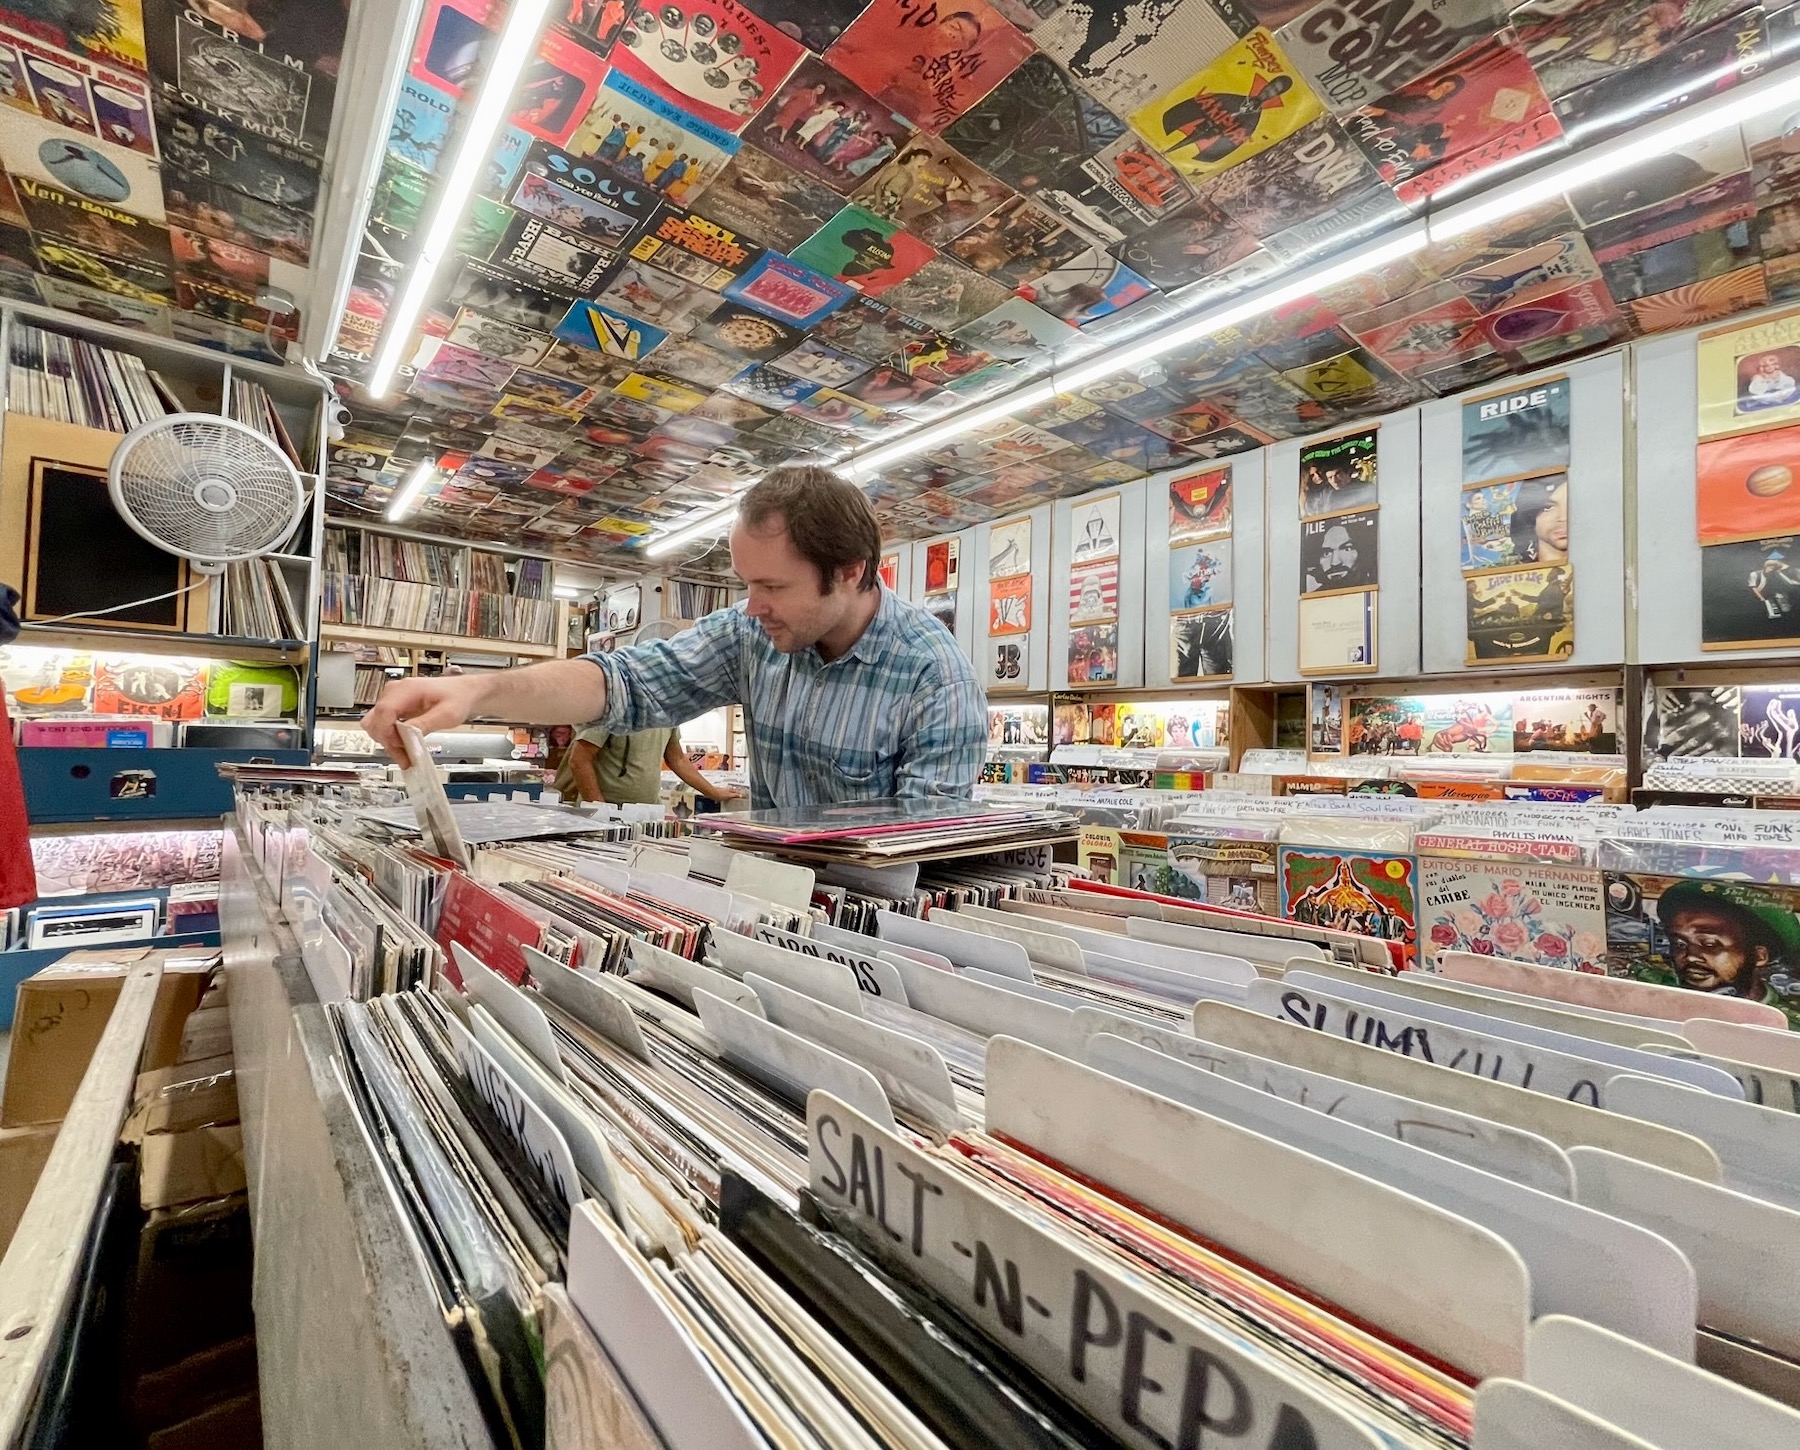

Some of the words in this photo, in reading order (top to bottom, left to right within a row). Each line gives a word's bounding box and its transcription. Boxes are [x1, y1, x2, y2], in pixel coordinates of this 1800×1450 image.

[1315, 61, 1367, 106] MOP
[163, 82, 233, 123] FOLK
[242, 119, 314, 151] MUSIC
[685, 118, 730, 148] STAND
[1293, 132, 1362, 196] DNA
[547, 154, 642, 207] SOUL
[859, 297, 890, 314] EDDIE
[899, 315, 925, 331] HAZEL
[1480, 389, 1548, 419] RIDE
[995, 644, 1021, 679] JB
[1519, 694, 1571, 702] ARGENTINA
[1576, 693, 1611, 701] NIGHTS
[37, 725, 68, 733] WEST
[1492, 830, 1536, 841] PHYLLIS
[1537, 833, 1574, 843] HYMAN
[1754, 823, 1792, 834] FUNK
[1754, 833, 1793, 842] JONES
[1417, 836, 1485, 851] GENERAL
[1489, 841, 1579, 858] HOSPI-TALE
[1422, 859, 1461, 872] EXITOS
[1464, 863, 1478, 873] DE
[1484, 866, 1523, 878] MARIO
[1528, 868, 1604, 885] HERNANDEZ
[1426, 889, 1471, 908] CARIBE
[1571, 885, 1599, 893] PLAYING
[1555, 901, 1601, 912] INGENIERO
